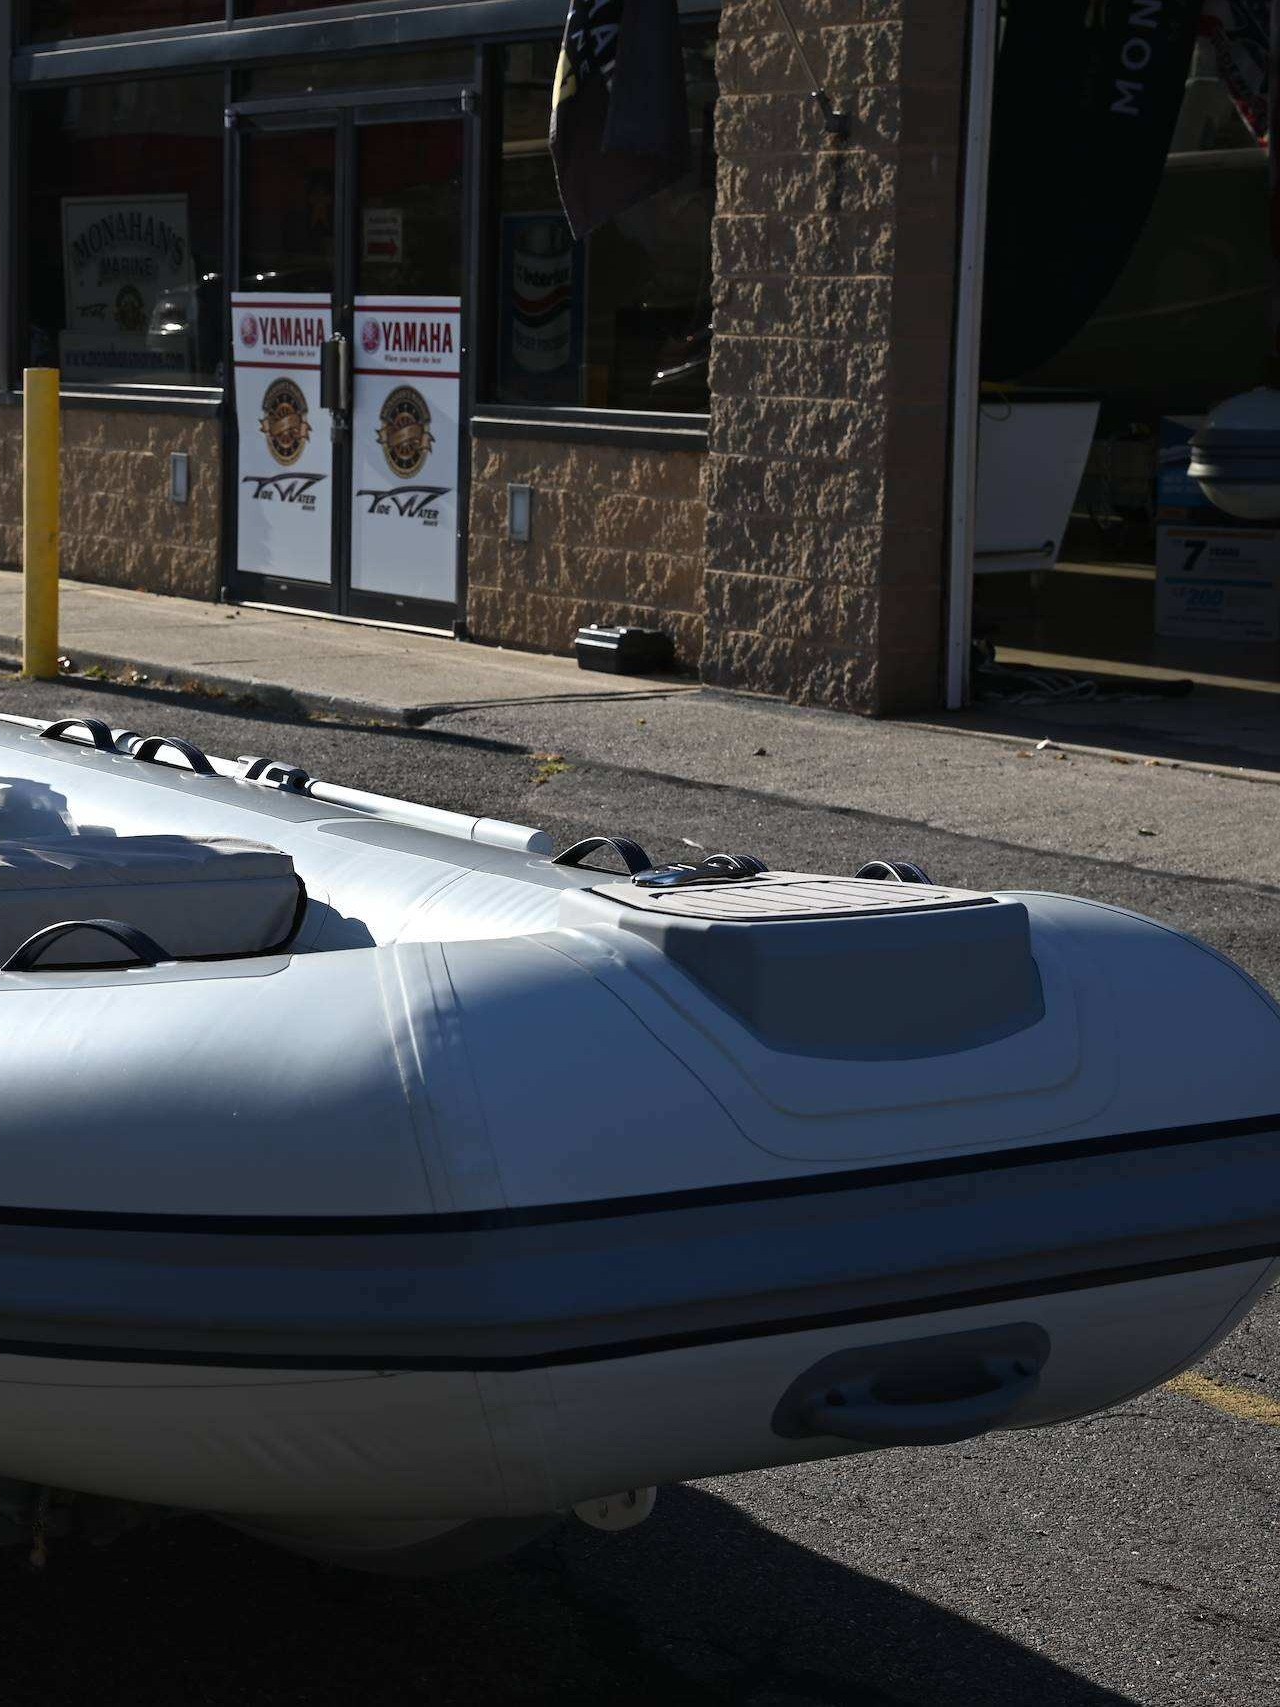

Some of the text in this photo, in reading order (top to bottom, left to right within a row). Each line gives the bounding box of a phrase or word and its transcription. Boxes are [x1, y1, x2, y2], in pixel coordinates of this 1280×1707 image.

[73, 211, 184, 267] MONAHAN'S
[101, 256, 153, 276] MARINE
[259, 316, 325, 347] YAMAHA
[382, 321, 453, 353] YAMAHA
[242, 472, 327, 504] TIDE WATER
[356, 485, 452, 520] TIDE WATER
[1183, 540, 1206, 571] 7
